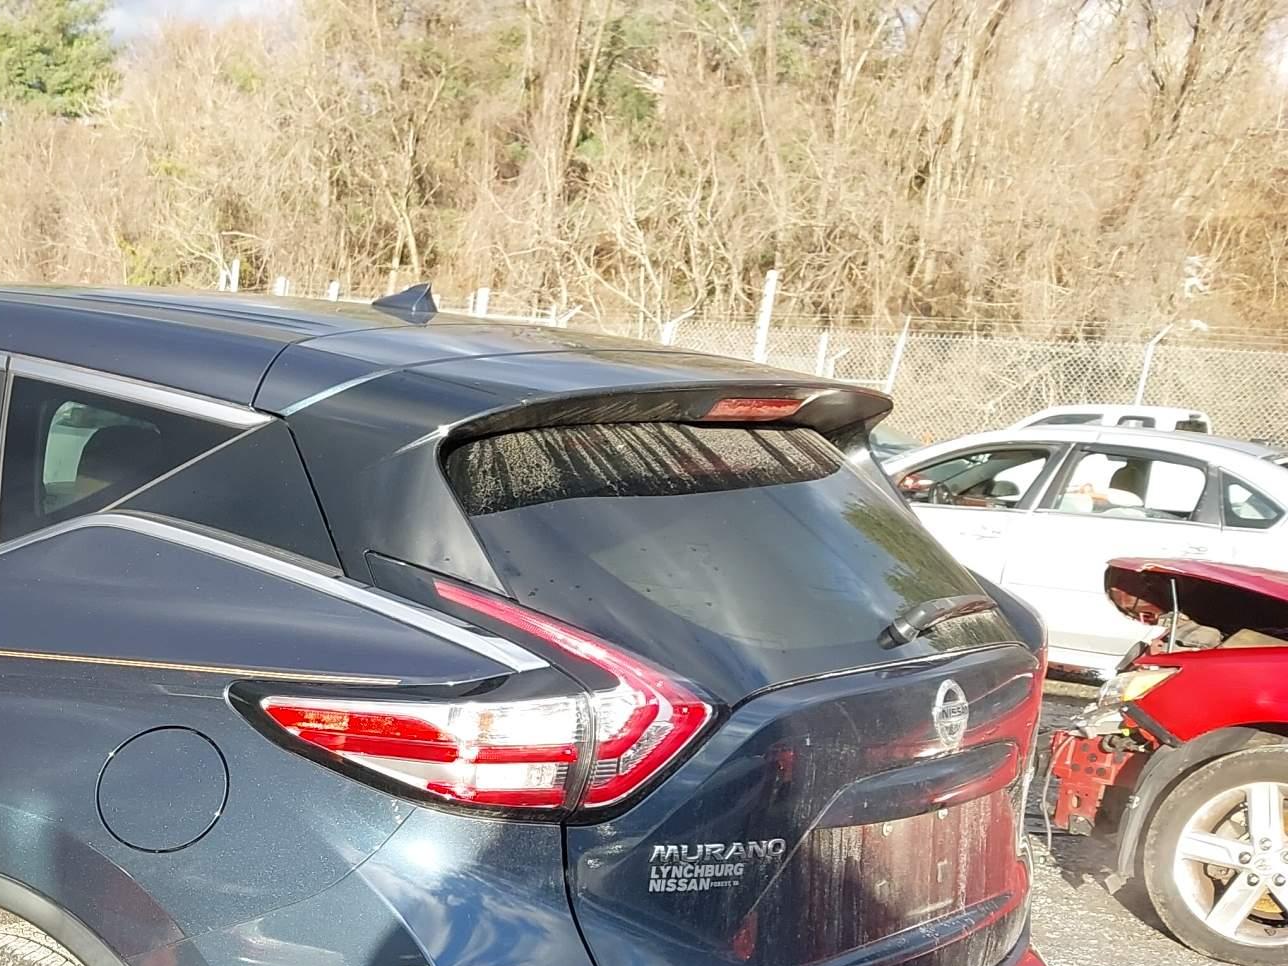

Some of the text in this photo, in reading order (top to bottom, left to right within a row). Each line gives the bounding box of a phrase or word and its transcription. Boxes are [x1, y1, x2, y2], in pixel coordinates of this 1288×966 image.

[649, 838, 787, 863] MURANO
[650, 863, 744, 878] LYNCHBURG
[648, 877, 710, 892] NISSAN
